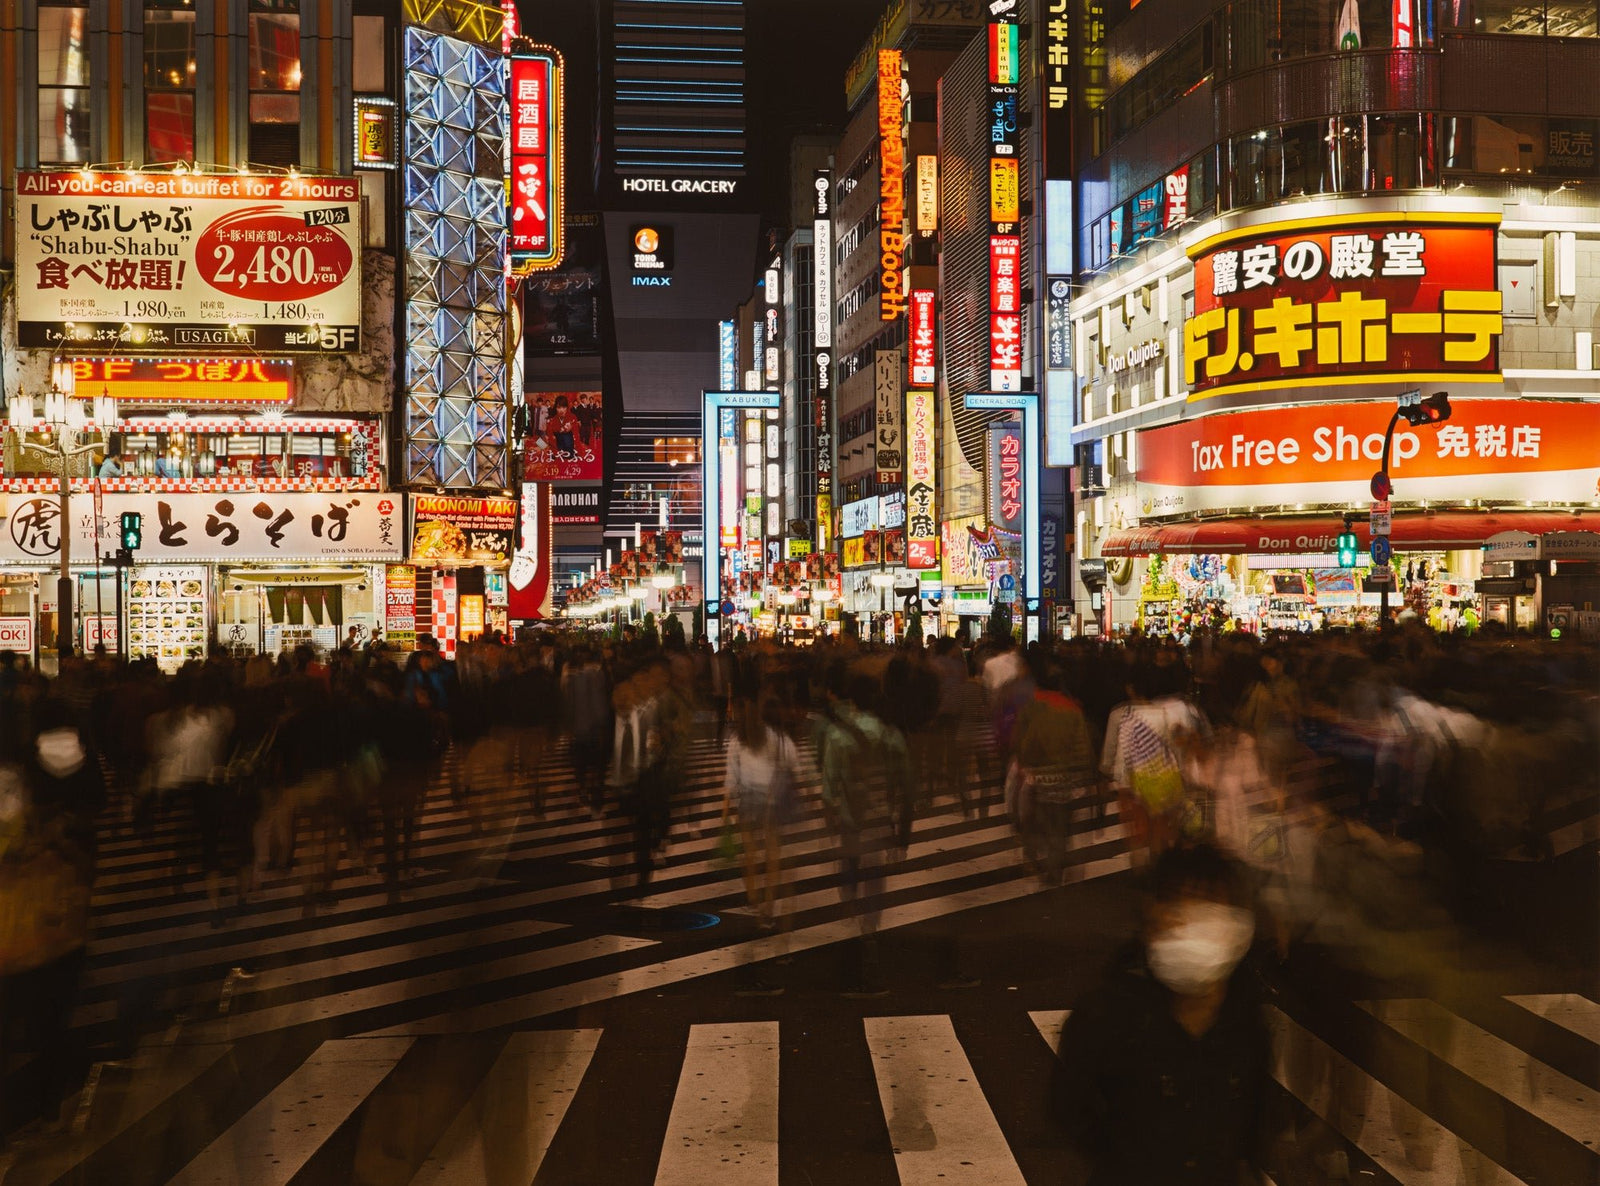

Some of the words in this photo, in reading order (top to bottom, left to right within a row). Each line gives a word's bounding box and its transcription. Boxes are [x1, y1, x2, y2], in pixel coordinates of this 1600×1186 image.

[518, 79, 539, 148] 居酒屋
[24, 175, 176, 195] All-you-can-eat
[182, 177, 240, 196] buffet
[246, 178, 273, 197] for
[280, 181, 293, 197] 2
[299, 180, 354, 198] hours
[624, 179, 669, 191] HOTEL
[671, 180, 736, 193] GRACERY
[31, 203, 192, 233] しゃぶしゃぶ
[306, 210, 346, 226] 120分
[997, 223, 1012, 233] 6F
[634, 254, 656, 262] TOHO
[1212, 232, 1427, 296] 驚安の殿堂
[632, 277, 670, 286] IMAX
[997, 259, 1014, 311] 居楽屋
[320, 329, 355, 349] 5F
[550, 335, 566, 344] 4.22
[1108, 354, 1125, 374] Don
[1127, 340, 1161, 368] Quijote
[1191, 440, 1224, 472] Tax
[1231, 433, 1300, 468] Free
[1312, 425, 1421, 469] Shop
[1436, 424, 1541, 460] 免税店
[528, 449, 596, 464] ちはやふる
[564, 467, 581, 477] 4.29
[881, 472, 897, 483] B1
[1001, 435, 1021, 520] カラオケ
[417, 498, 483, 513] OKONOMI
[486, 500, 516, 514] YAKI
[909, 481, 935, 538] 金の蔵
[157, 498, 361, 549] とらそば
[1259, 537, 1290, 549] Don
[1295, 536, 1338, 549] Quijo
[1042, 520, 1057, 586] カラオケ
[1042, 588, 1056, 597] B1
[1, 629, 26, 641] OK!
